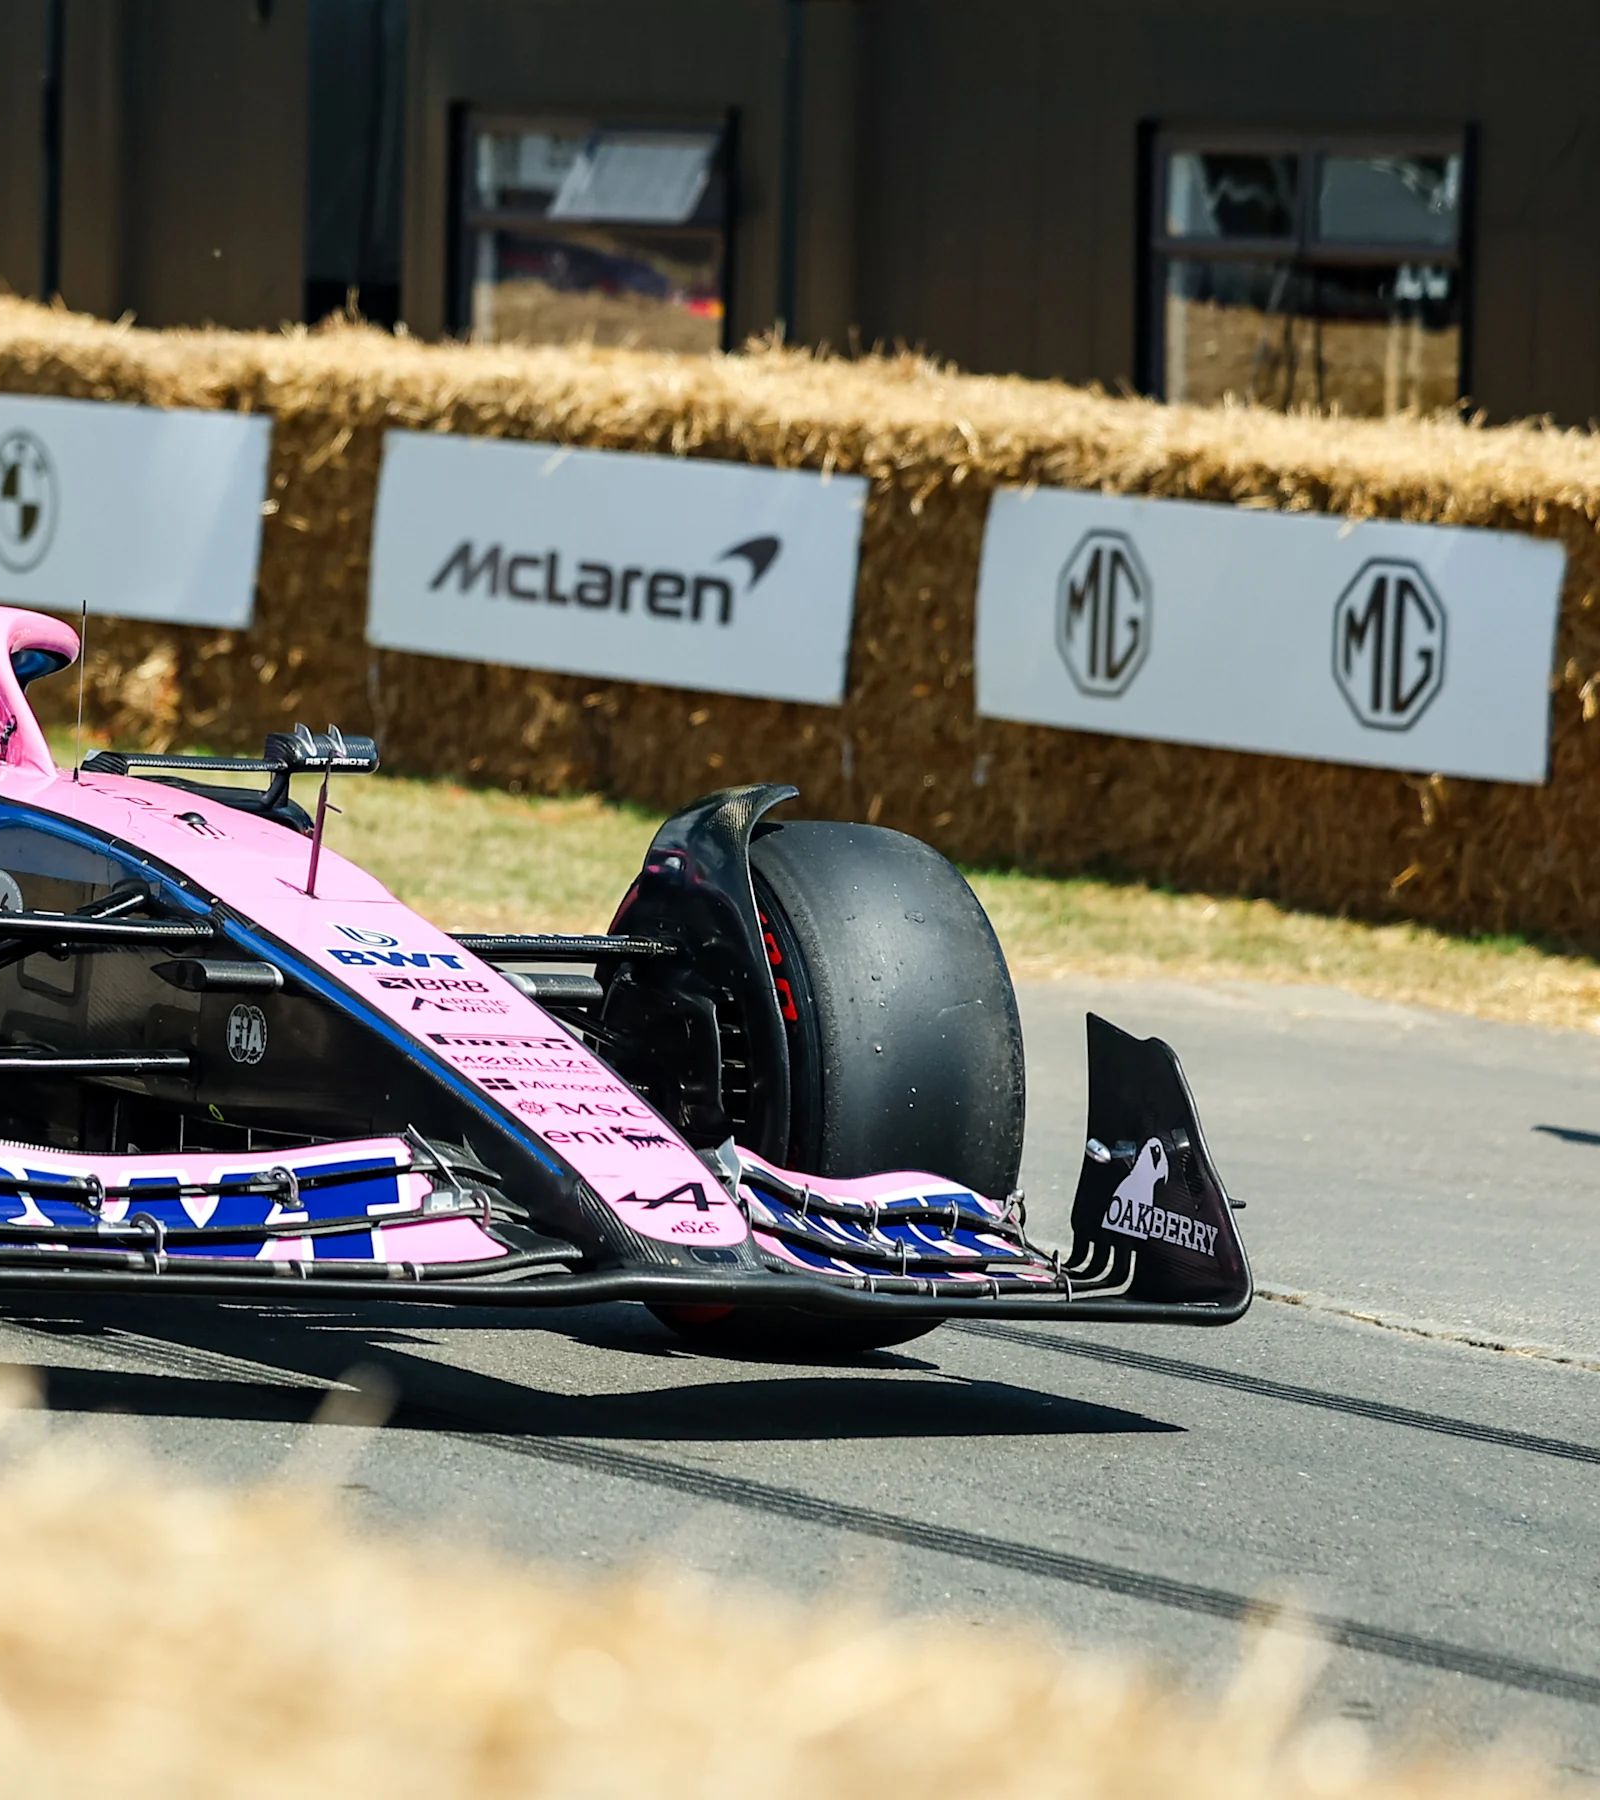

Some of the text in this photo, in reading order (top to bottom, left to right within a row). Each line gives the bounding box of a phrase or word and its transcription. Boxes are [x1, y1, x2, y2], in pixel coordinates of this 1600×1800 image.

[429, 539, 733, 626] McLaren
[1065, 547, 1141, 680] MG
[1344, 575, 1435, 713] MG
[325, 949, 466, 970] BWT
[414, 978, 491, 993] BRB
[440, 997, 510, 1007] ARCTIC
[455, 1006, 510, 1015] WOLF
[426, 1033, 573, 1050] PIRELLI
[519, 1080, 628, 1095] Microsoft
[553, 1101, 653, 1119] MSC
[542, 1126, 615, 1144] eni
[1106, 1194, 1219, 1257] OAKBERRY
